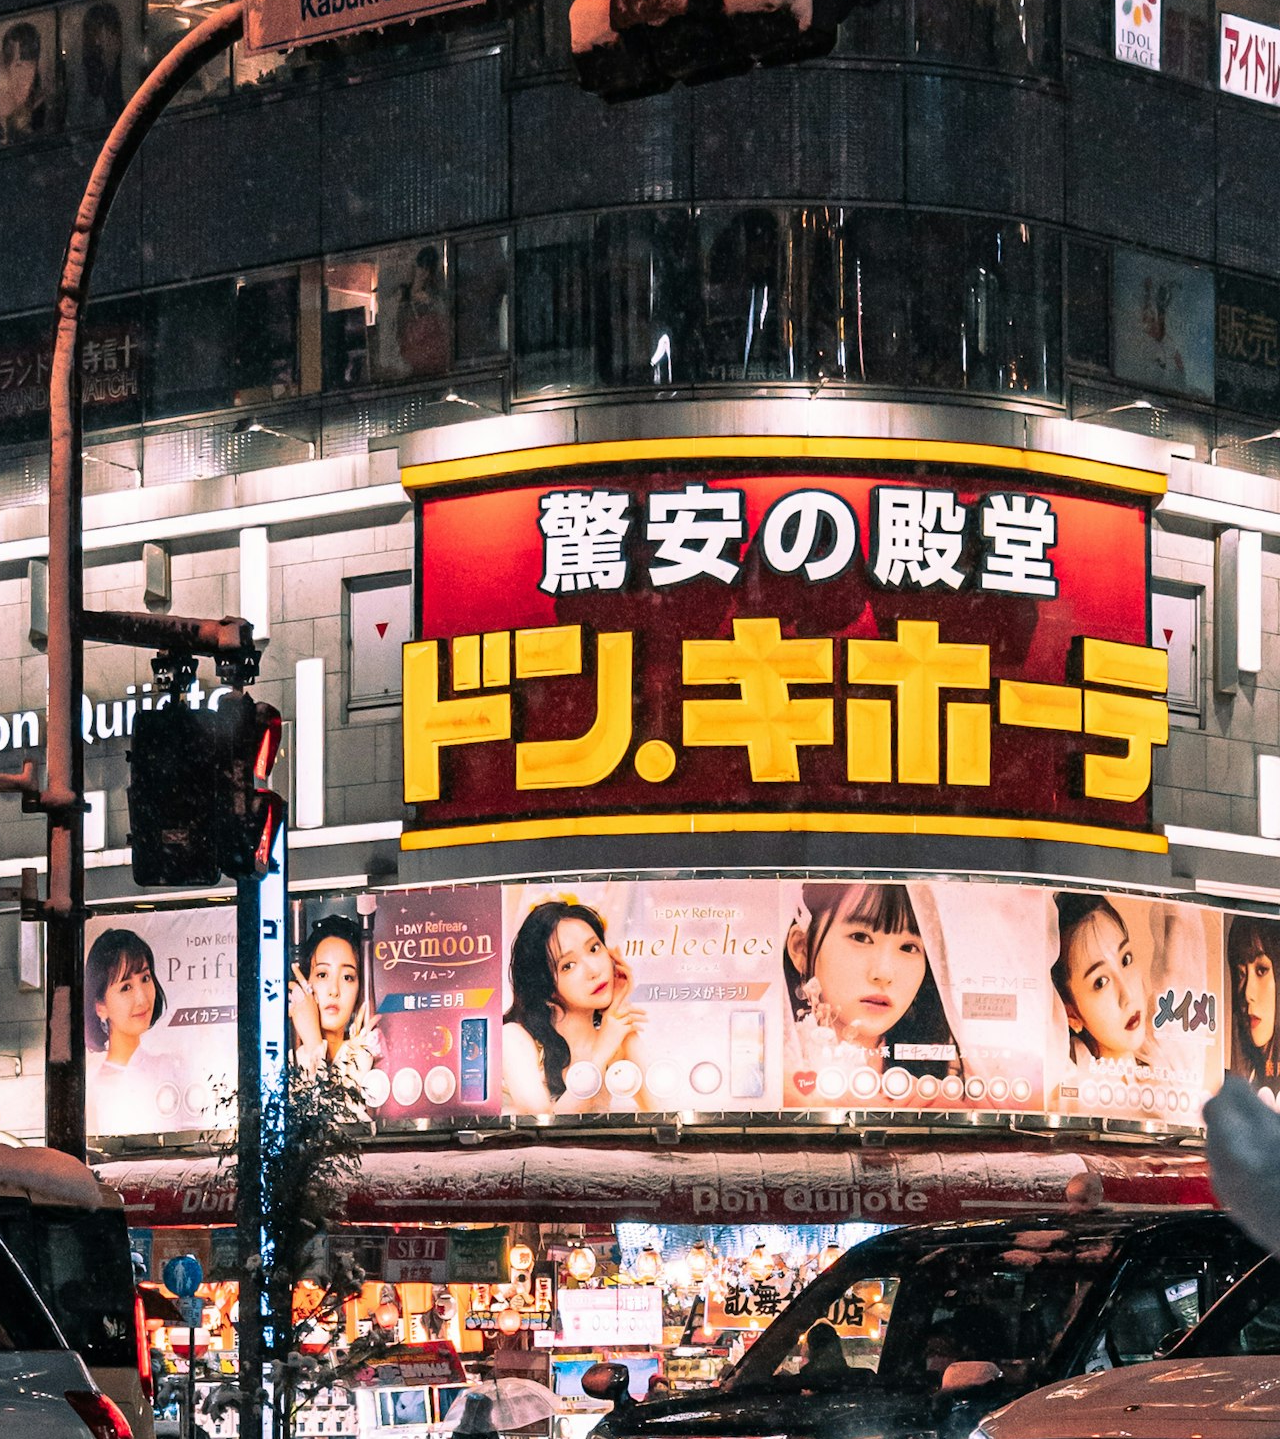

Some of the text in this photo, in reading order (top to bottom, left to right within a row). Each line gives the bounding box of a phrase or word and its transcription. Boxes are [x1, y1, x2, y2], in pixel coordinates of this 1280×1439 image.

[1121, 28, 1151, 51] IDOL
[1118, 44, 1154, 66] STAGE
[83, 371, 138, 404] ATCH
[540, 483, 1058, 598] 驚安の殿堂
[624, 924, 774, 957] meleches
[262, 918, 282, 1062] ゴジラ
[412, 969, 456, 982] アイムーン
[648, 985, 750, 1001] パールラメがキラリ
[182, 1186, 237, 1213] Don
[692, 1184, 929, 1221] Don Quijote
